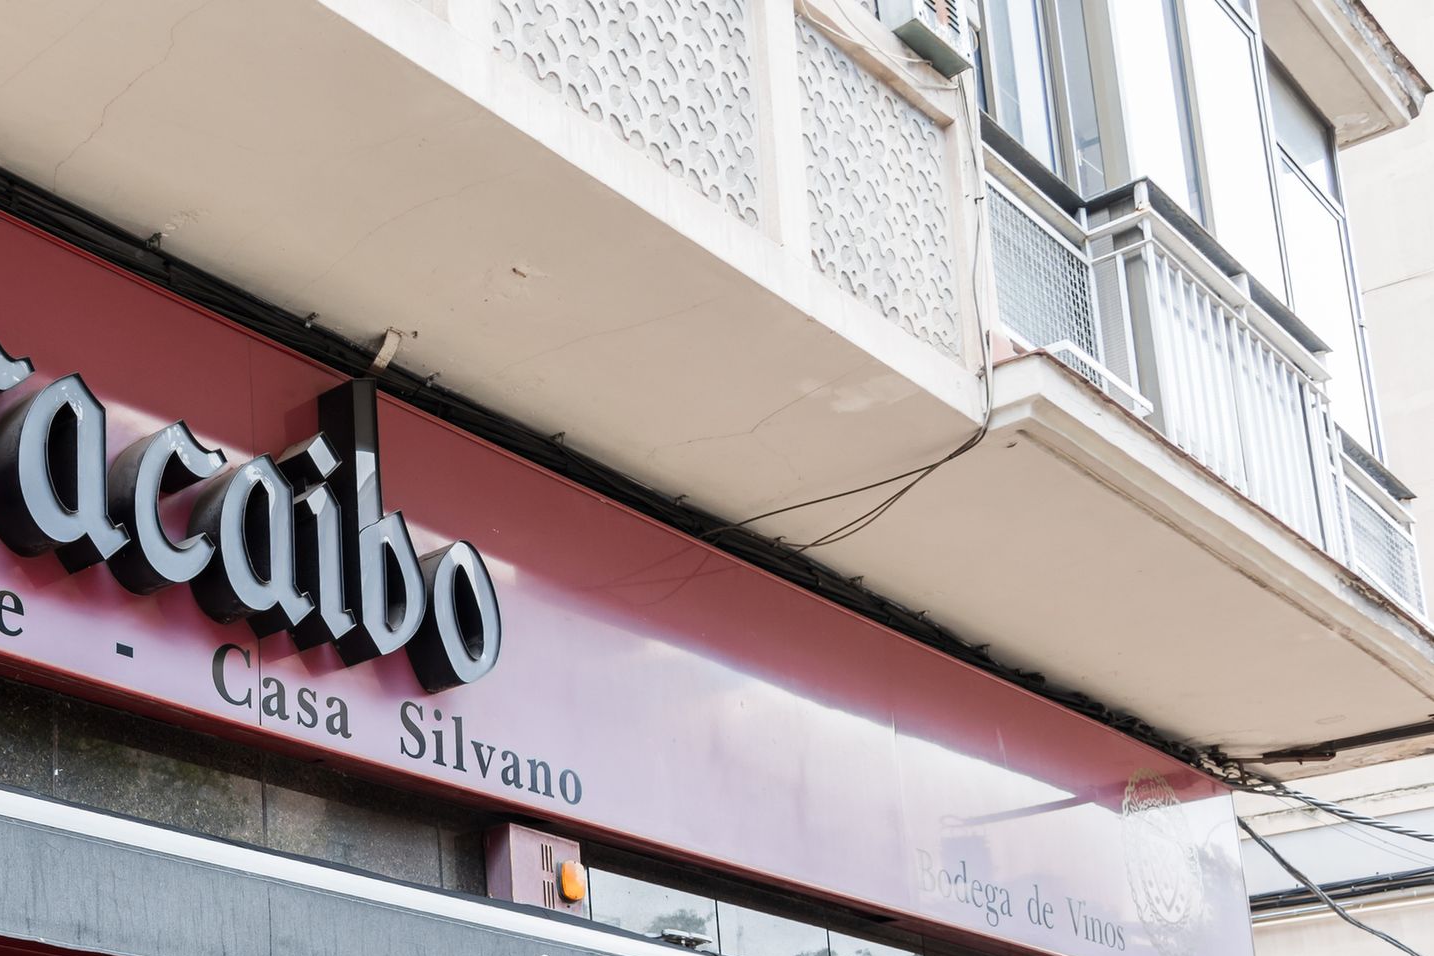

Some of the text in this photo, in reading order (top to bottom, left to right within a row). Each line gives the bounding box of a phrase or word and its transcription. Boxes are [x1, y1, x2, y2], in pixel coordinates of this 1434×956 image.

[212, 643, 352, 739] Casa
[400, 701, 583, 805] Silvano
[916, 848, 1126, 951] Bodega de Vinos
